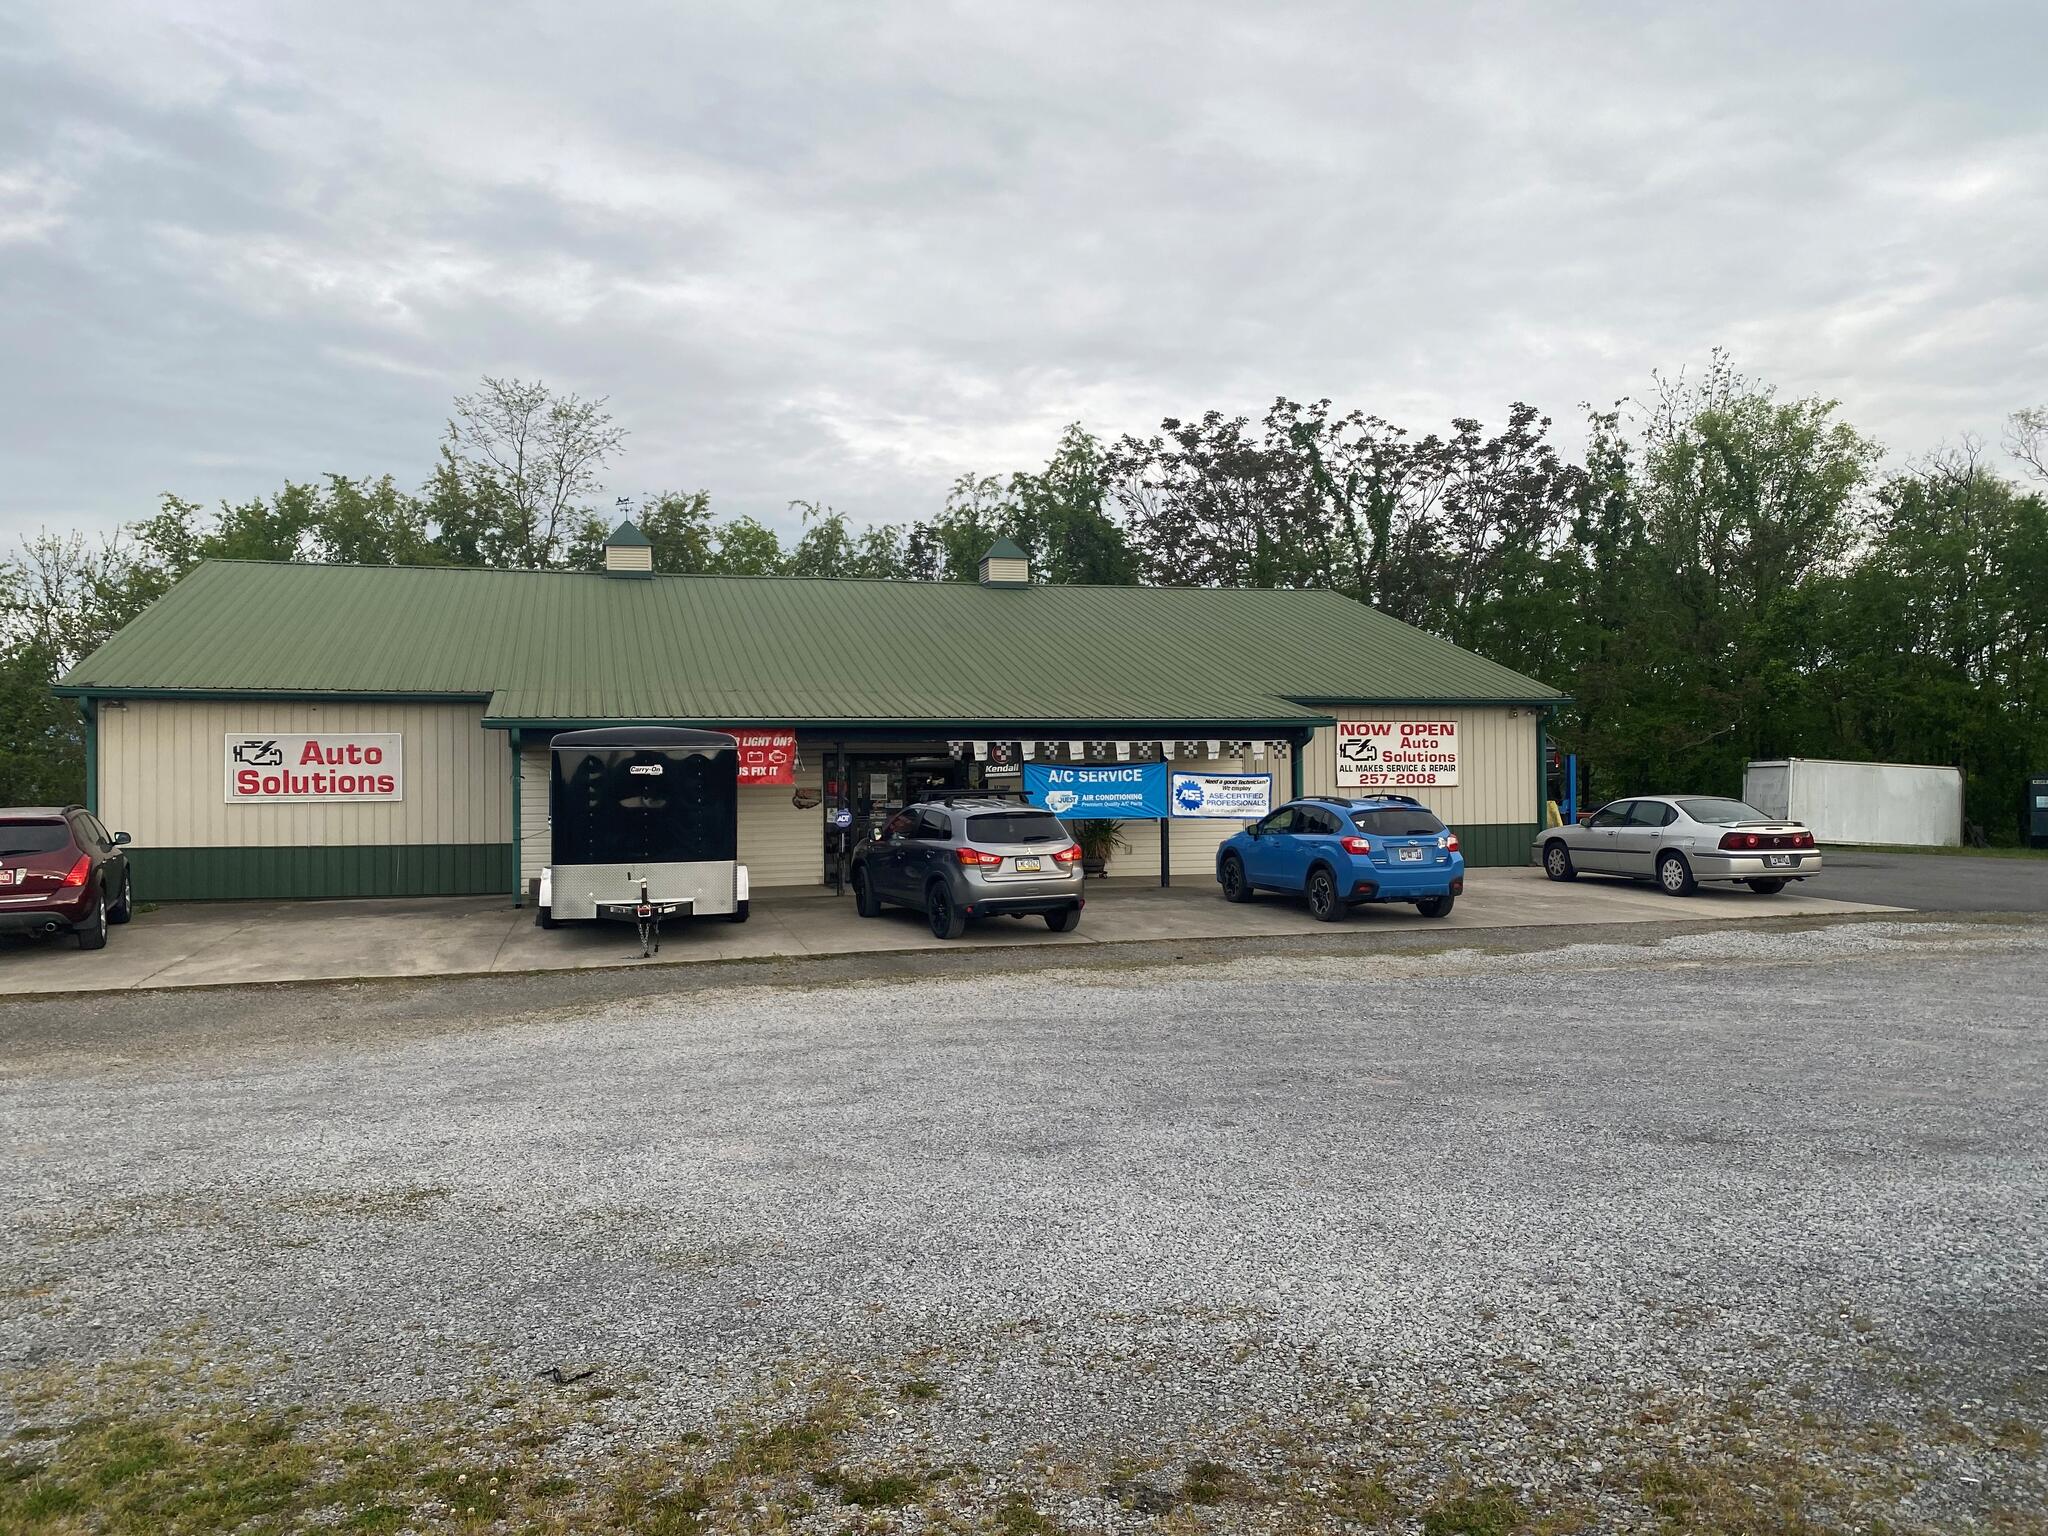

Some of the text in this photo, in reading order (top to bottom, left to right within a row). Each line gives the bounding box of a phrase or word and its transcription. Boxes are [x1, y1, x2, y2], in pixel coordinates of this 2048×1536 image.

[1340, 724, 1455, 736] NOW OPEN
[742, 736, 771, 747] LIGHT
[773, 736, 793, 747] ON?
[1400, 737, 1439, 749] Auto
[299, 740, 383, 765] Auto
[1382, 751, 1456, 763] Solutions
[631, 766, 661, 774] Carry-On
[751, 766, 767, 776] FIX
[769, 766, 778, 776] IT
[985, 764, 1019, 773] Kendall
[1340, 765, 1353, 773] ALL
[1355, 765, 1384, 773] MAKES
[1386, 765, 1418, 773] SERVICE
[1429, 764, 1456, 772] REPAIR
[1048, 769, 1143, 783] A/C SERVICE
[1359, 773, 1436, 784] 257-2008
[237, 769, 395, 795] Solutions
[1095, 793, 1143, 801] CONDITIONING
[1178, 789, 1201, 801] ASE
[1209, 792, 1264, 800] ASE-CERTIFIED
[1206, 799, 1267, 807] PROFESSIONALS
